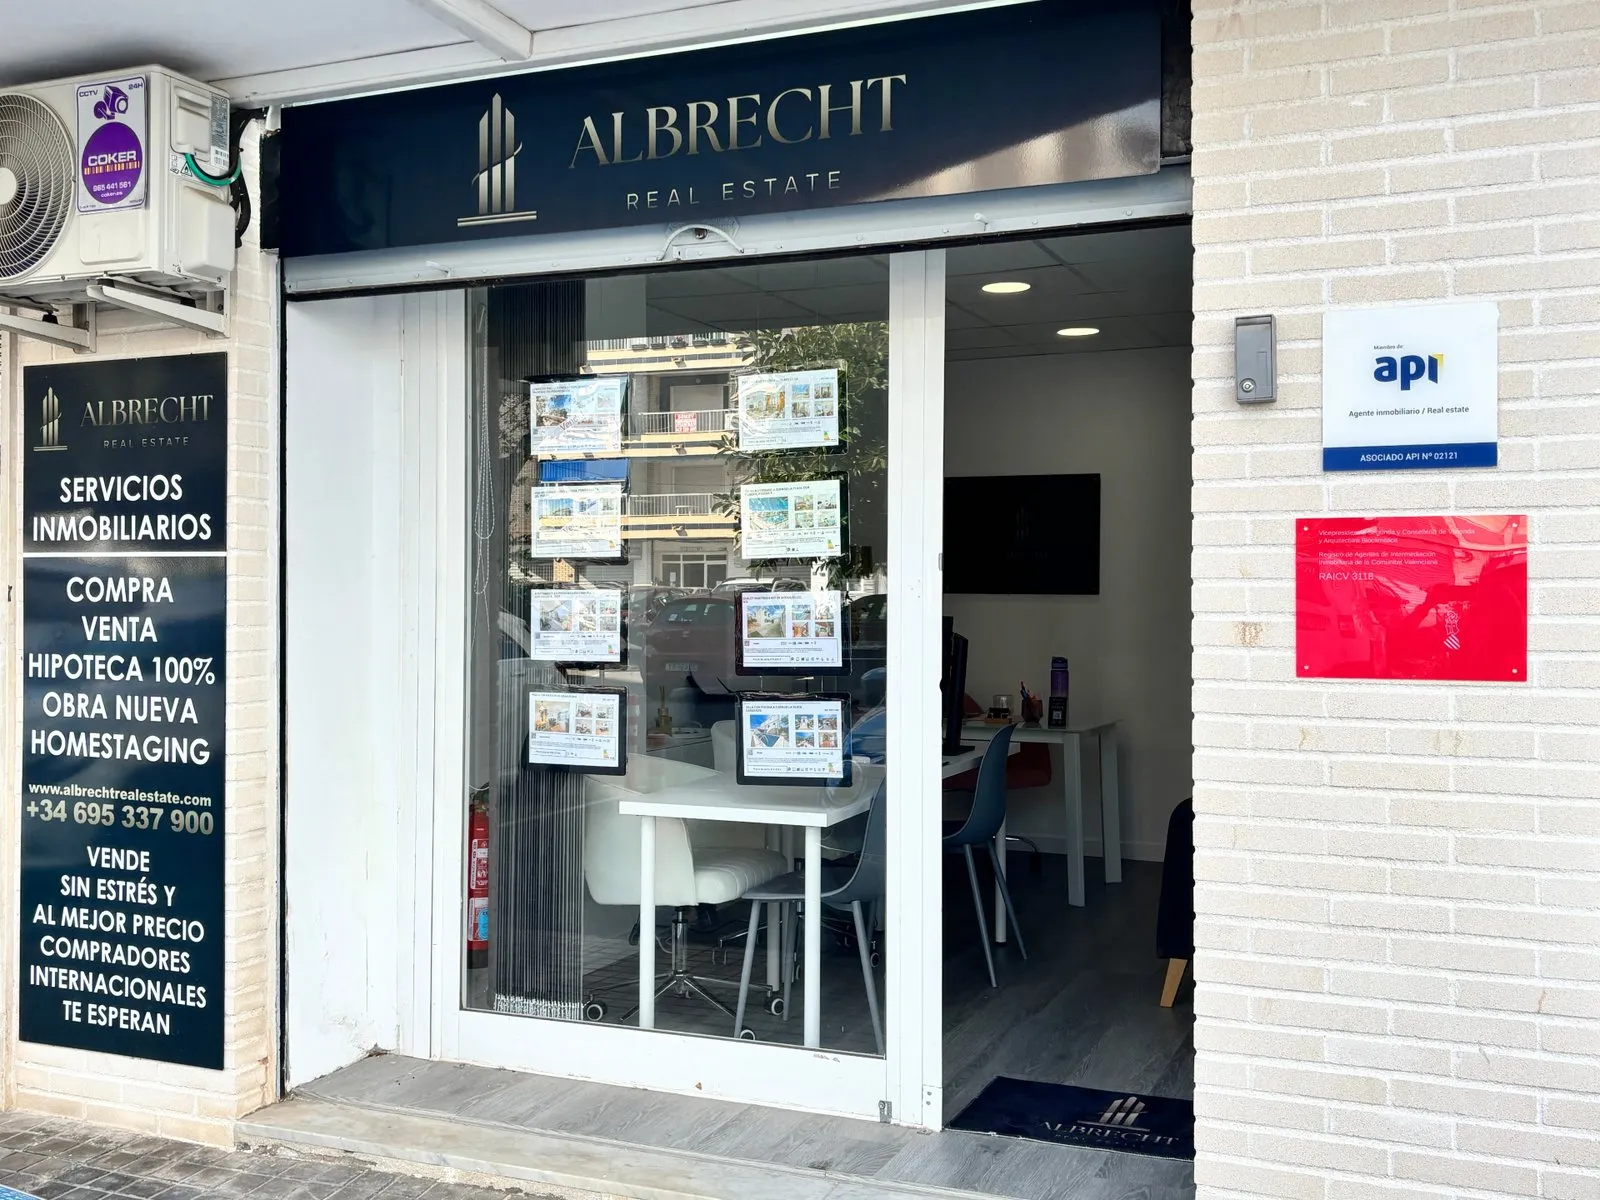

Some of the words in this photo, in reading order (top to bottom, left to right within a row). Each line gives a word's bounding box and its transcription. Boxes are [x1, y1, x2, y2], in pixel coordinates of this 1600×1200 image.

[79, 89, 98, 97] CCTV
[128, 82, 143, 90] 24H
[569, 74, 907, 168] ALBRECHT
[88, 150, 137, 167] COKER
[106, 182, 118, 190] 441
[627, 187, 699, 211] REAL
[722, 171, 842, 201] ESTATE
[1374, 354, 1443, 391] api
[80, 394, 214, 427] ALBRECHT
[1349, 410, 1374, 418] Agente
[1376, 408, 1420, 416] inmobiliario
[104, 438, 133, 449] REAL
[142, 436, 189, 447] ESTATE
[1360, 453, 1404, 462] ASOCIADO
[1406, 452, 1420, 461] API
[1422, 452, 1432, 460] Nº
[1434, 451, 1458, 460] 02121
[60, 474, 183, 503] SERVICIOS
[33, 513, 212, 542] INMOBILIARIOS
[66, 576, 174, 603] COMPRA
[1319, 572, 1349, 581] RAICV
[1352, 572, 1374, 581] 3118
[81, 616, 158, 642] VENTA
[28, 653, 144, 682] HIPOTECA
[152, 656, 215, 685] 100%
[42, 691, 108, 720] OBRA
[115, 694, 199, 724] NUEVA
[31, 729, 210, 765] HOMESTAGING
[28, 783, 212, 807] www.albrechtrealestate.com
[26, 799, 67, 823] +34
[73, 801, 115, 826] 695
[121, 805, 164, 831] 337
[170, 810, 214, 836] 900
[87, 846, 150, 872] VENDE
[60, 875, 90, 898] SIN
[97, 877, 158, 906] ESTRÉS
[164, 885, 176, 907] Y
[32, 903, 56, 926] AL
[61, 906, 127, 934] MEJOR
[133, 914, 205, 943] PRECIO
[40, 935, 190, 974] COMPRADORES
[30, 964, 207, 1009] INTERNACIONALES
[62, 1000, 82, 1023] TE
[88, 1003, 170, 1036] ESPERAN
